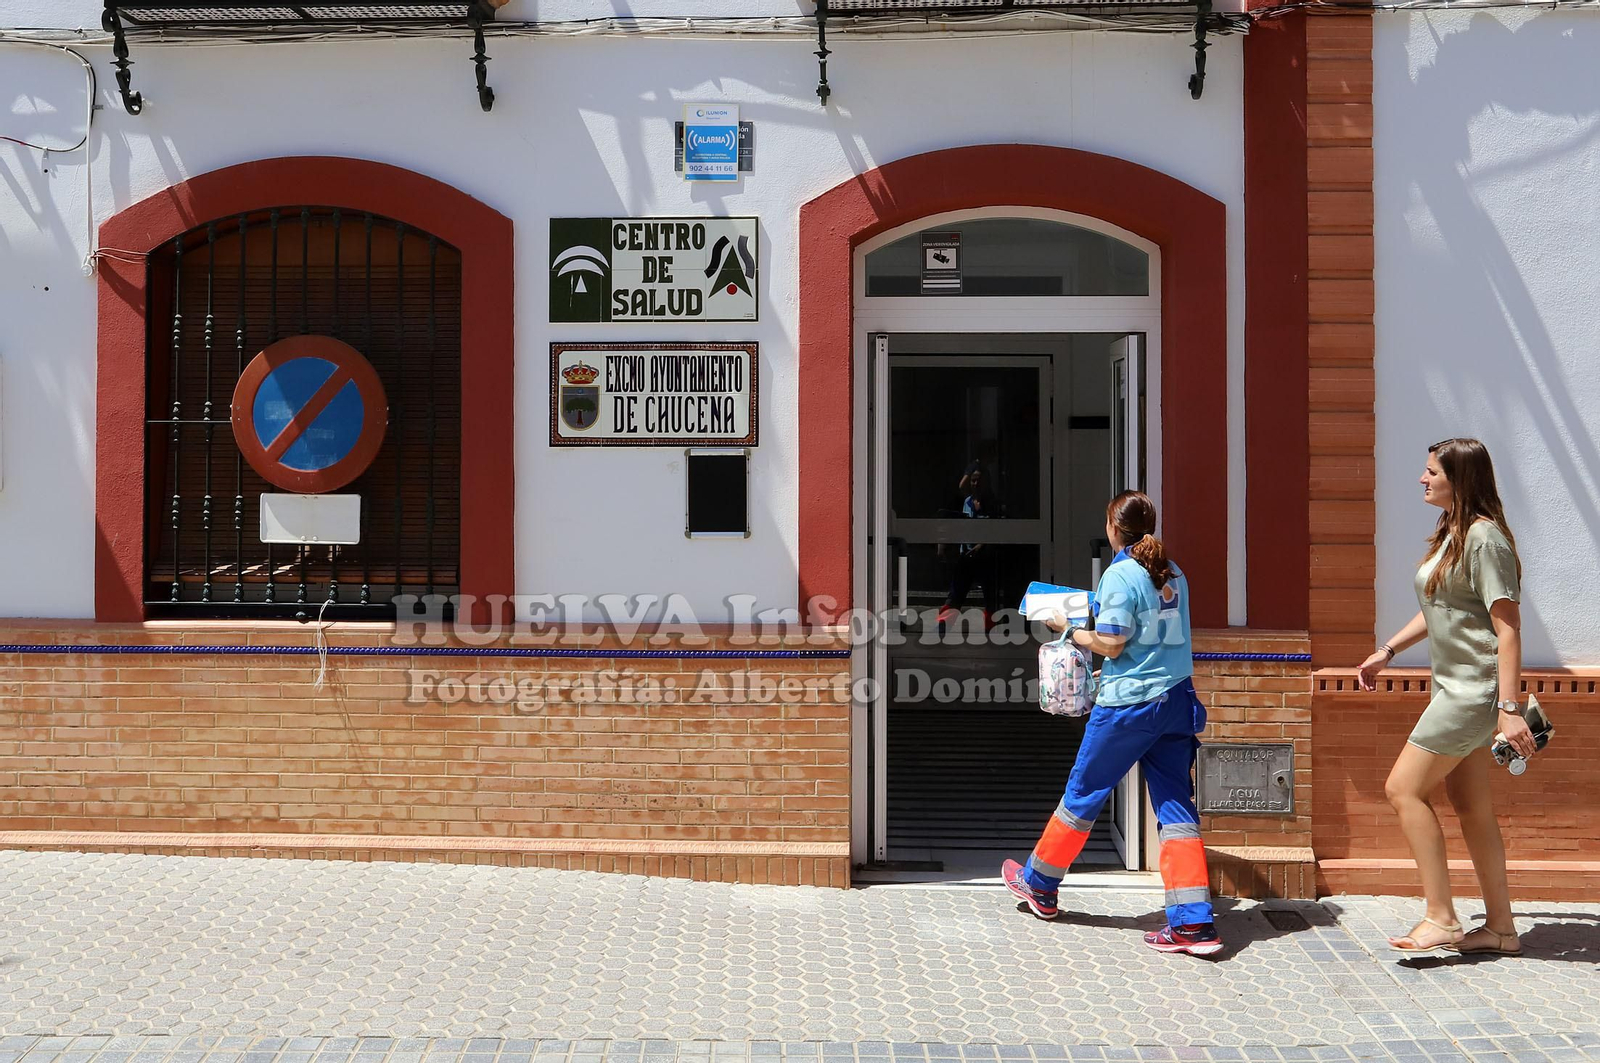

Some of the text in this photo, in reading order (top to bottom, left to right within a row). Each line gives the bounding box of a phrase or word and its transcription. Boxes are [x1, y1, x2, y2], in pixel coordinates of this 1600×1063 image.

[697, 136, 726, 144] ALARMA
[612, 223, 706, 251] CENTRO
[642, 256, 673, 283] DE
[612, 288, 703, 316] SALUD
[650, 355, 743, 393] AYUNTAMIENTO
[613, 396, 736, 433] DE CHUCENA
[1216, 749, 1274, 759] CONTADOR
[1228, 788, 1261, 798] AGUA
[1234, 800, 1245, 808] DE
